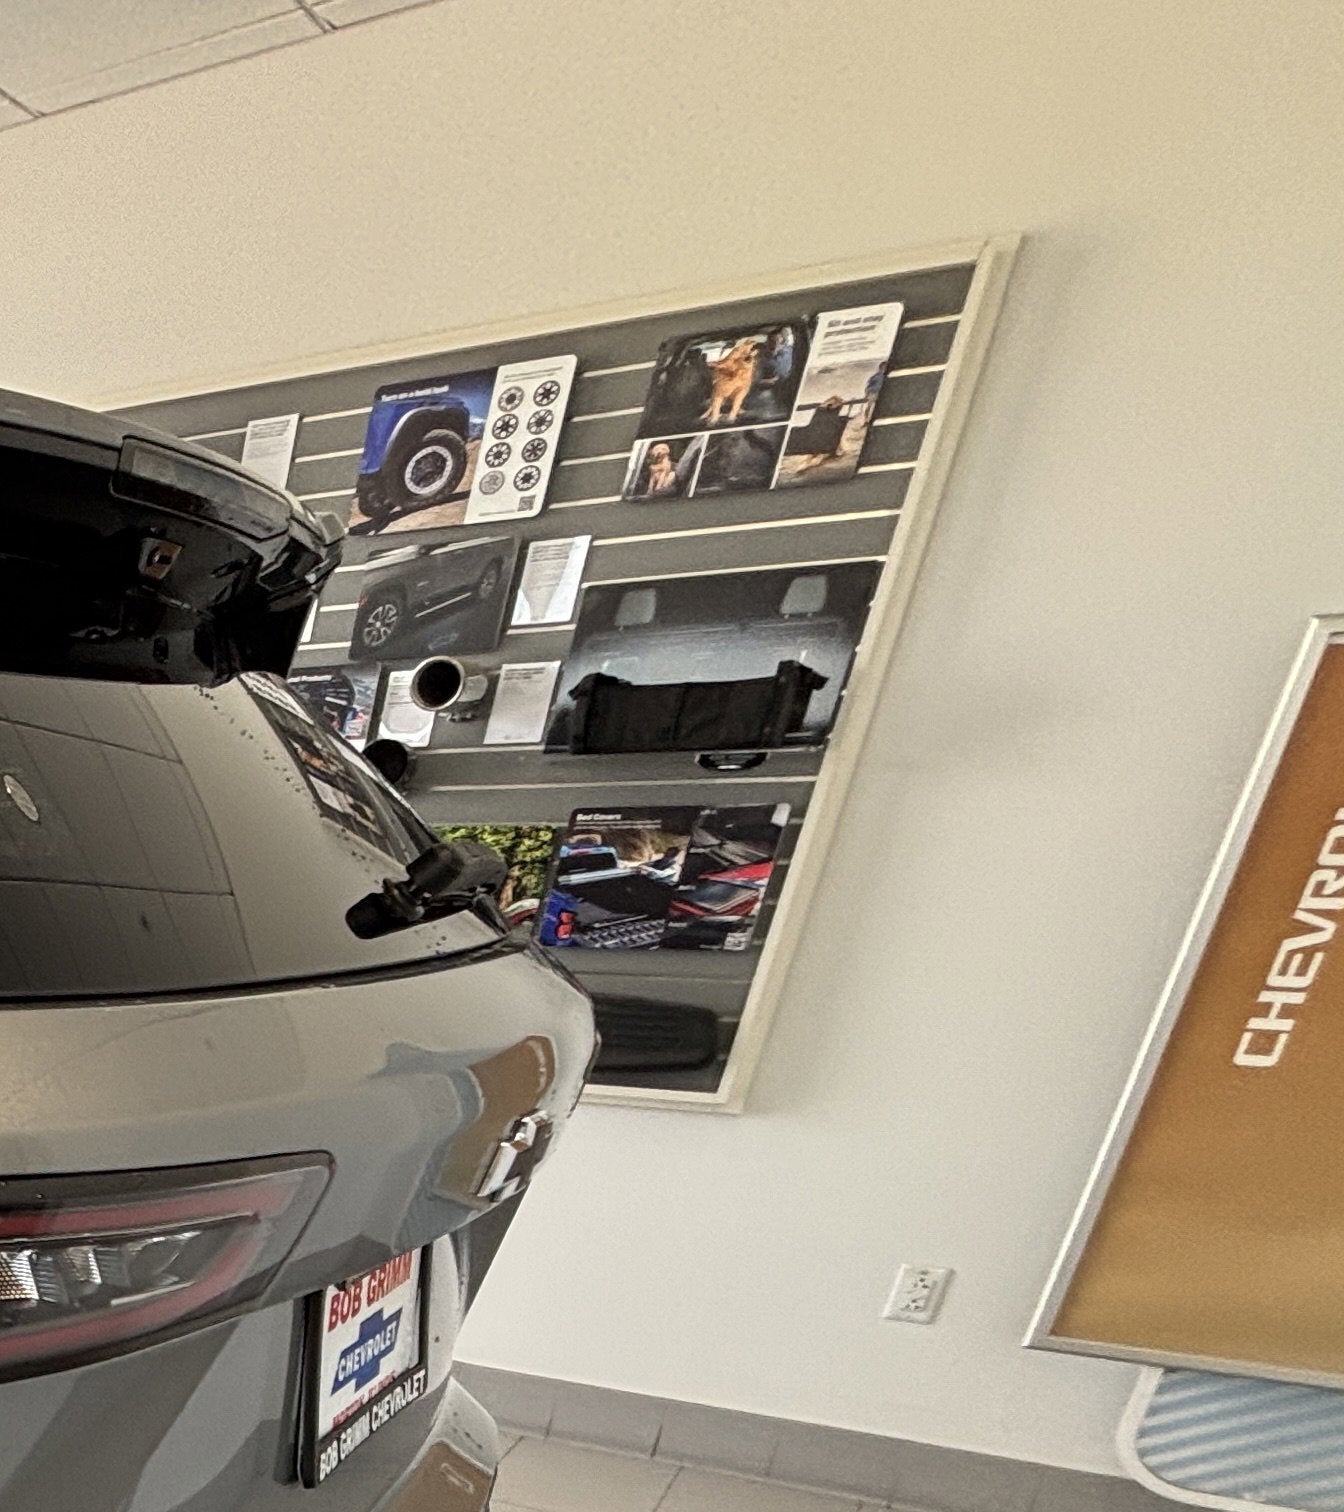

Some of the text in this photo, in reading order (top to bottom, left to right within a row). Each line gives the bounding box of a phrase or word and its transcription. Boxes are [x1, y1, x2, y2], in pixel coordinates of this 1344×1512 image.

[1232, 807, 1344, 1068] CHEVR
[327, 1279, 362, 1334] BOB
[337, 1320, 397, 1382] CHEVROLET
[319, 1439, 339, 1482] BOB
[371, 1368, 426, 1432] CHEVROLET
